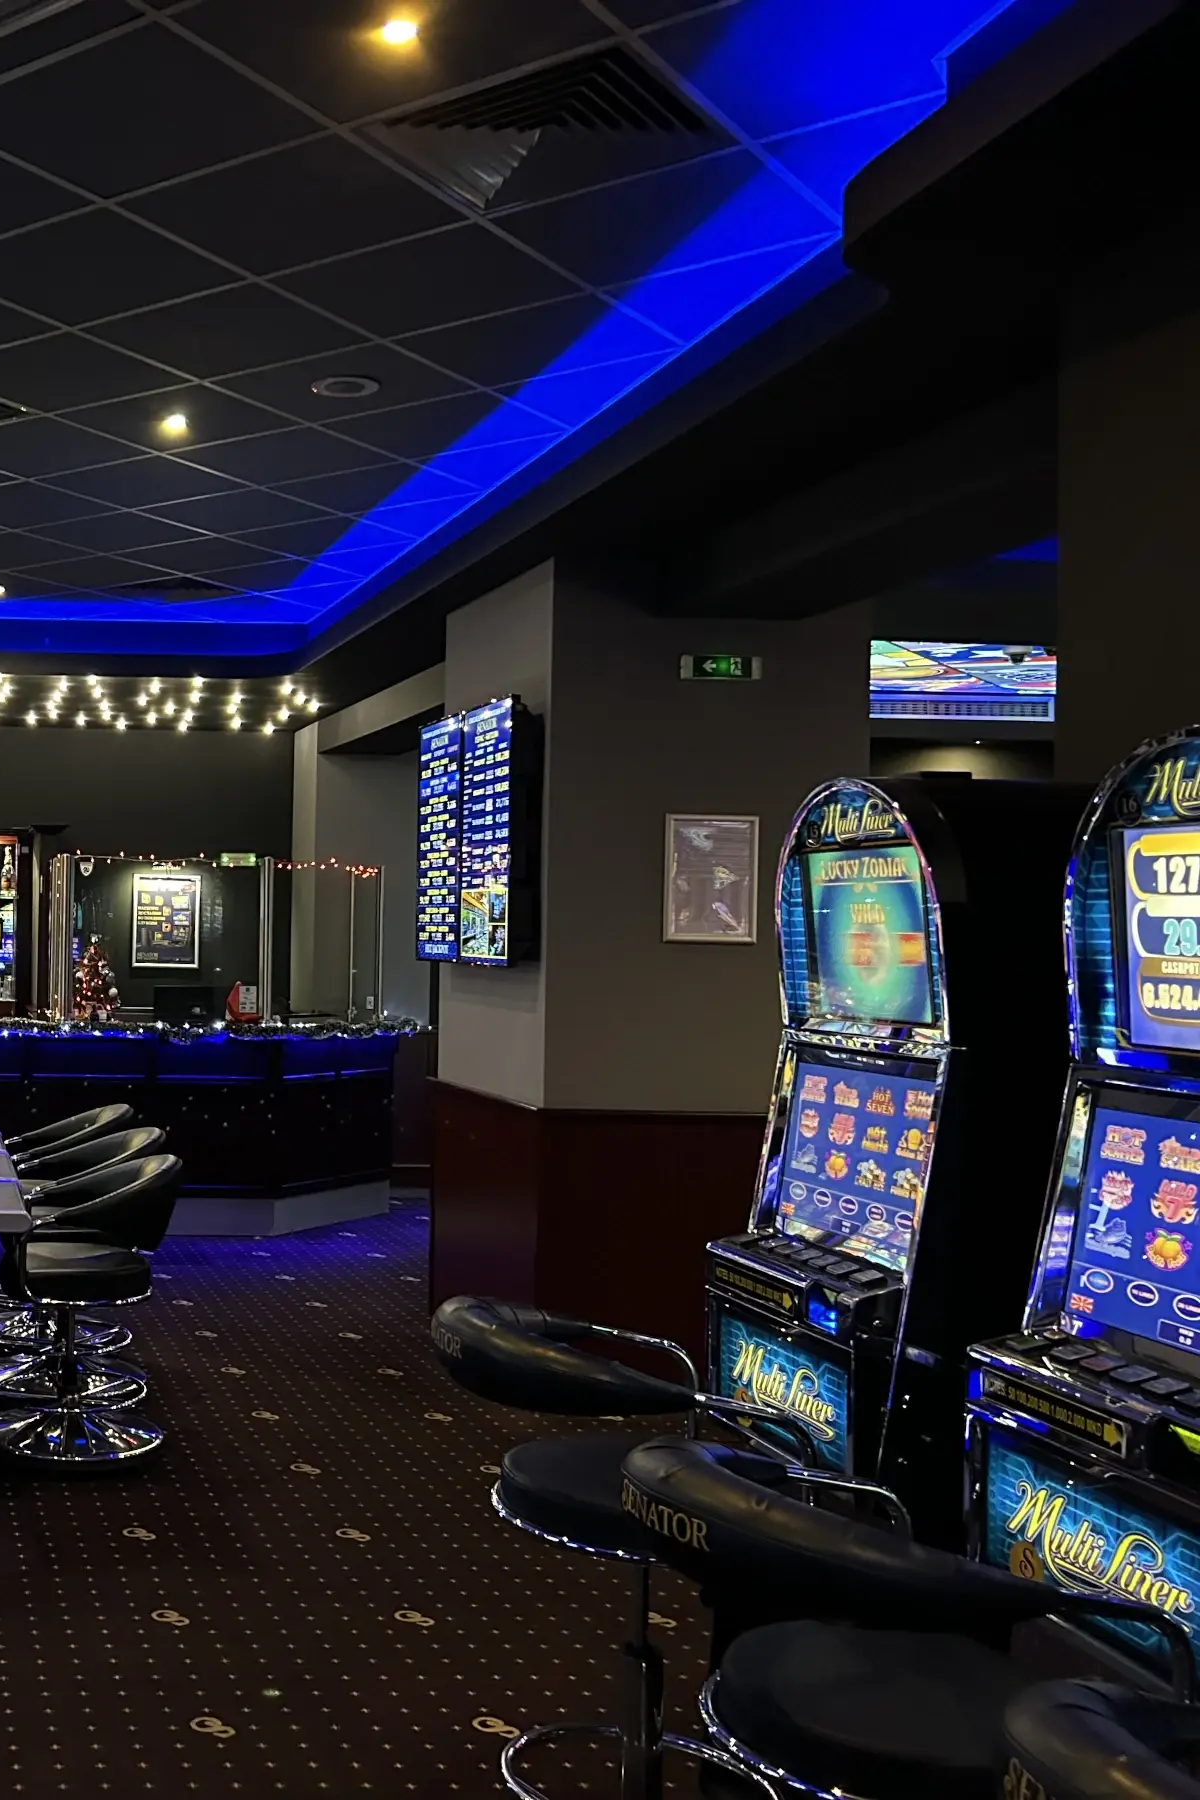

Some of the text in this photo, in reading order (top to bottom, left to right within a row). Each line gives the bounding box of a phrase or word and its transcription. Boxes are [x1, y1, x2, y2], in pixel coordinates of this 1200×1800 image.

[820, 799, 896, 845] Multi Liner
[821, 857, 911, 880] LUCKY ZODIAC
[1161, 960, 1200, 975] CASHPOT
[865, 1101, 896, 1117] SEVEN
[872, 1091, 891, 1103] HOT
[1105, 1125, 1147, 1149] HOT
[731, 1339, 836, 1424] Multi Liner
[621, 1478, 711, 1553] SENATOR
[1004, 1480, 1194, 1613] Multi Liner
